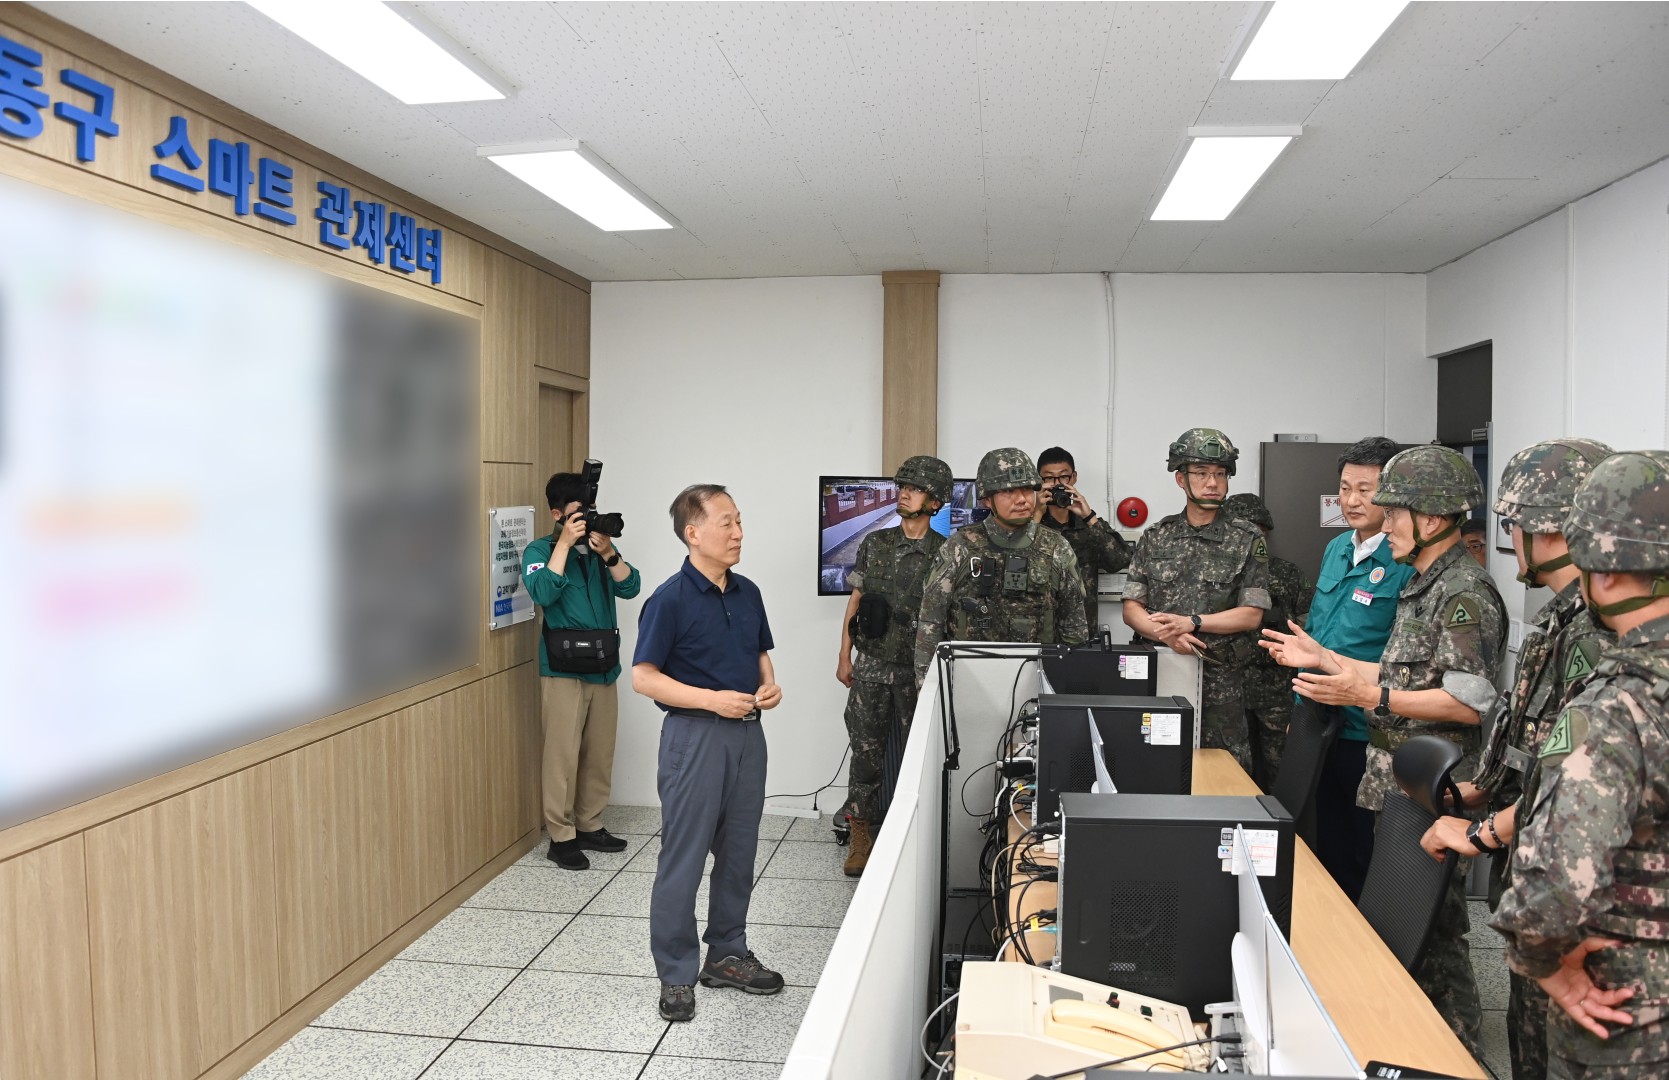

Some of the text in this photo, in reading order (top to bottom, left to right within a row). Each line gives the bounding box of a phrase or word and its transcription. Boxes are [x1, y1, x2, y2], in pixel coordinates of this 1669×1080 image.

[0, 35, 442, 284] 동구 스마트 관제센터
[1456, 609, 1467, 624] 2
